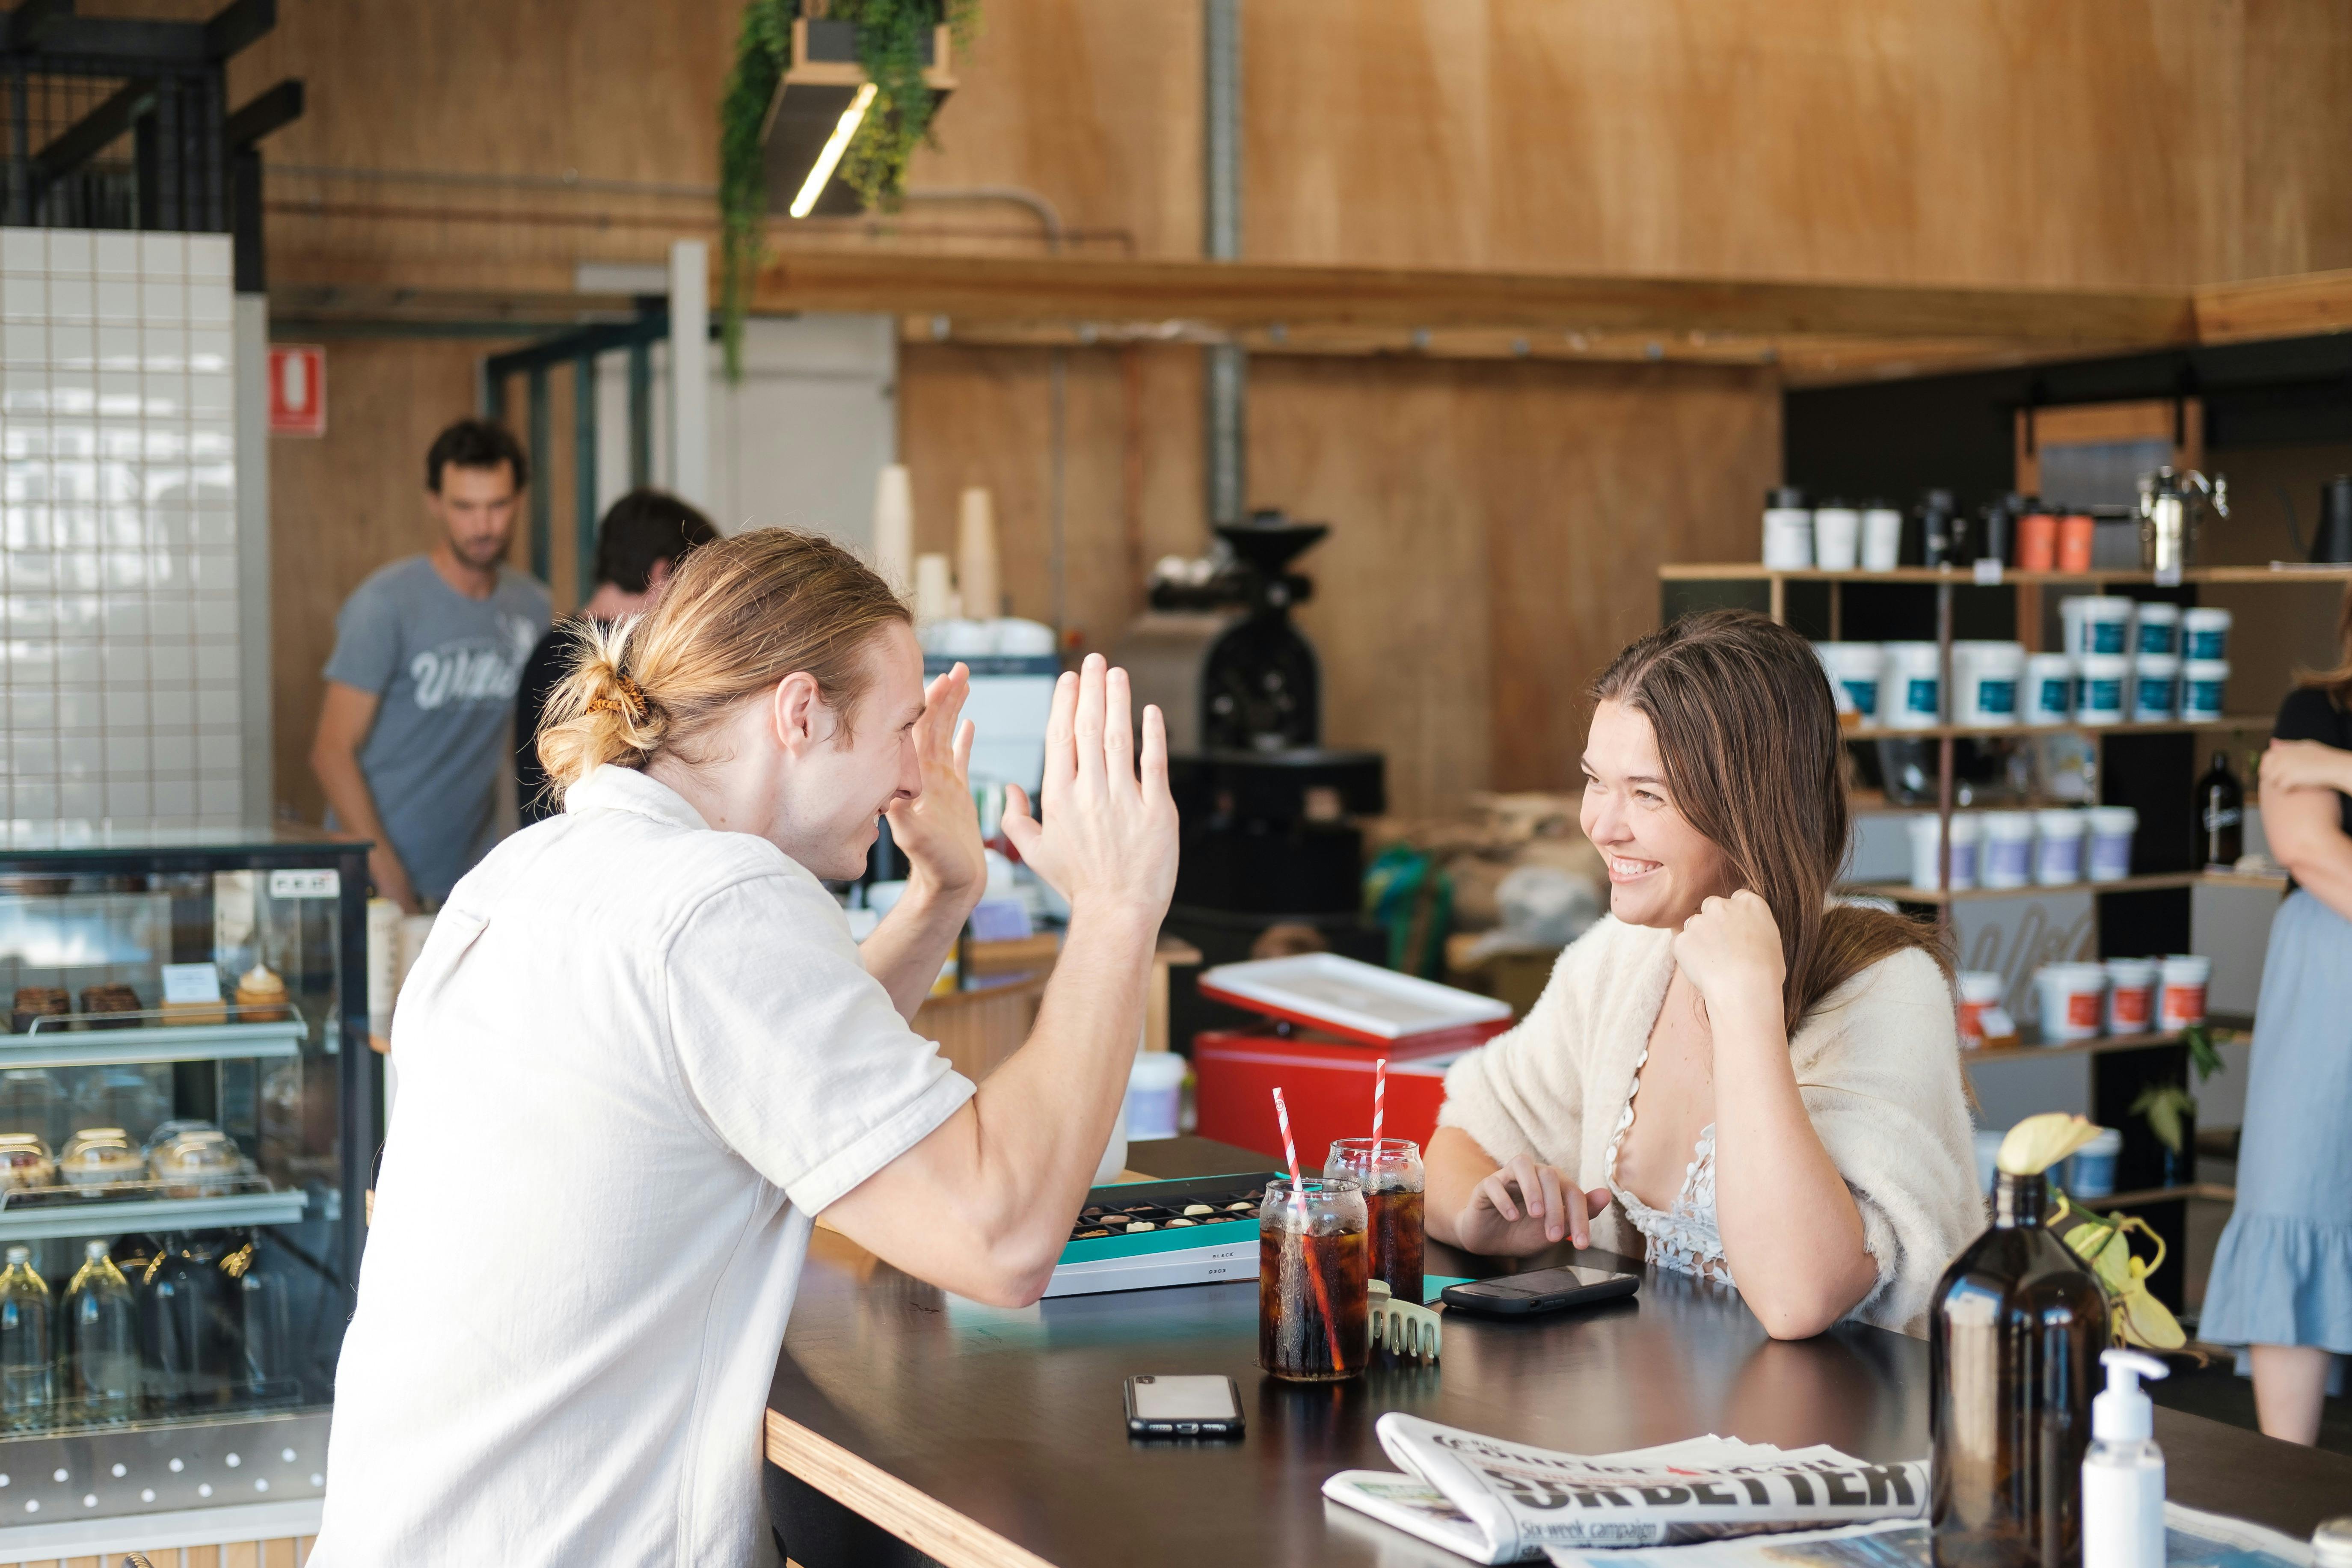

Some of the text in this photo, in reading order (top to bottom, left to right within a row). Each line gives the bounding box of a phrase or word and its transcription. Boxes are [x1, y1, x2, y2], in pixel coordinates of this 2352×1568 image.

[1432, 1435, 1652, 1474] Courier
[1520, 1518, 1657, 1540] Six-week campaign
